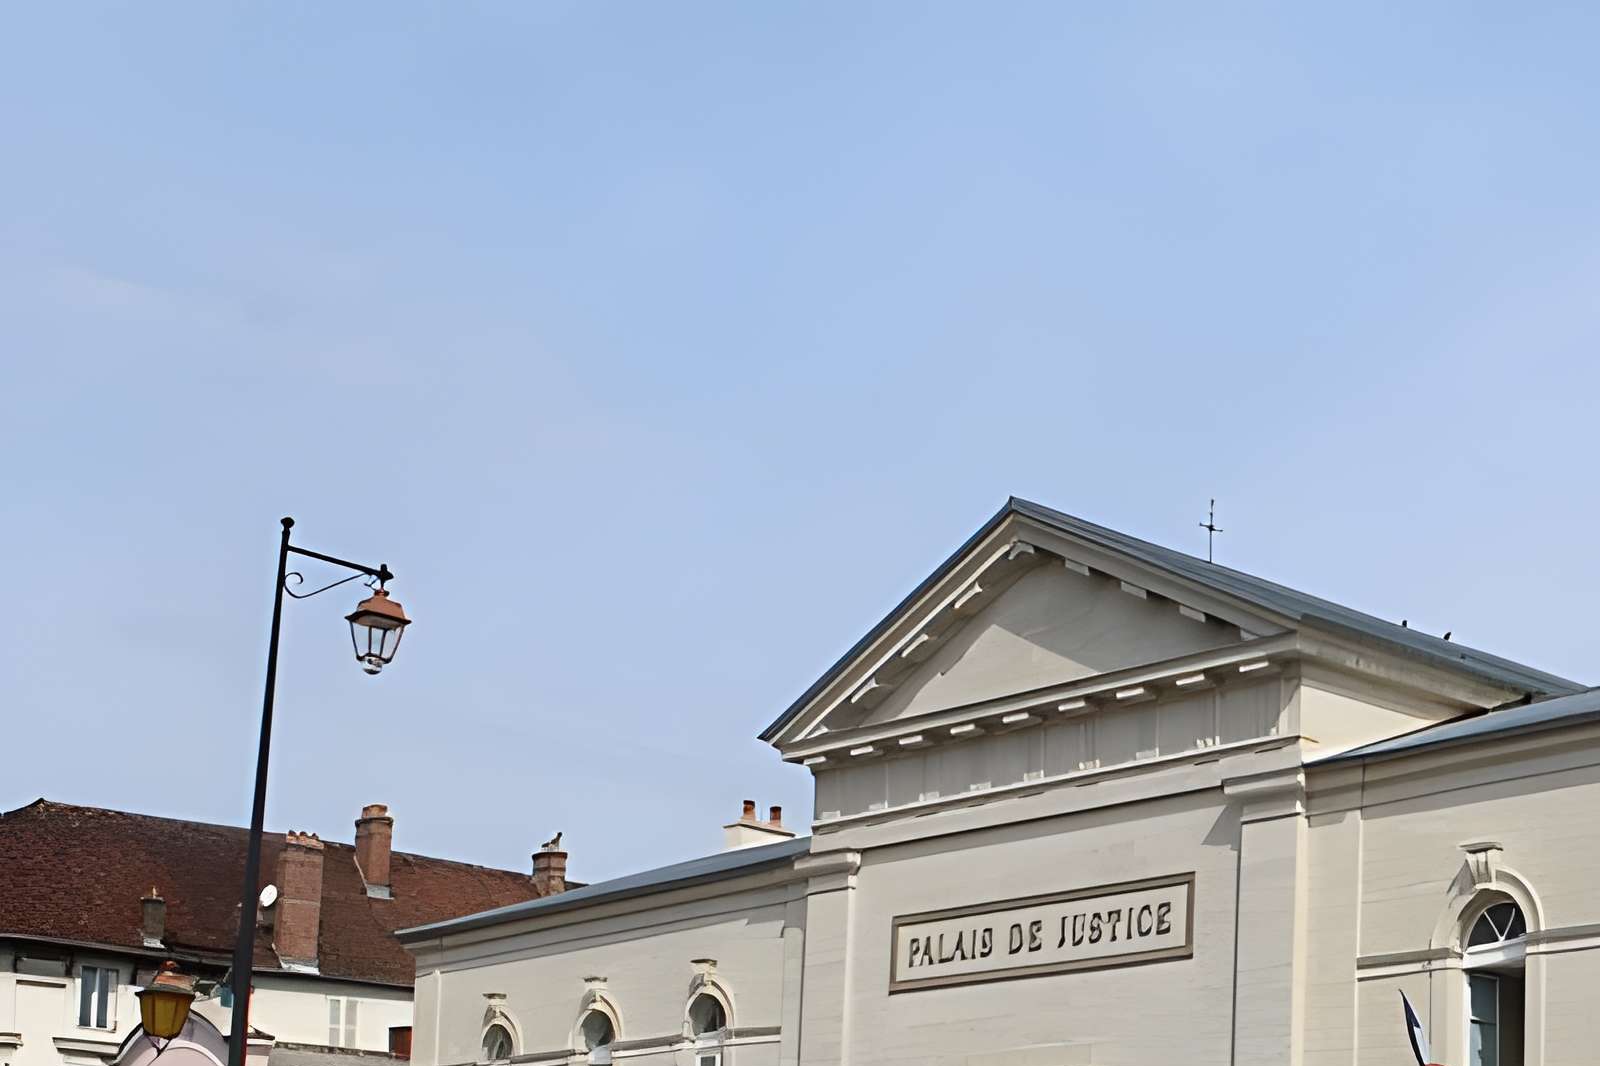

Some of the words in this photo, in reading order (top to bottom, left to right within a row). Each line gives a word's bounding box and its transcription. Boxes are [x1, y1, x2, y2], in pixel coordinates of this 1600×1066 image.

[908, 928, 993, 968] PALAIS
[1008, 920, 1042, 955] DE
[1057, 901, 1172, 948] JUSTICE
